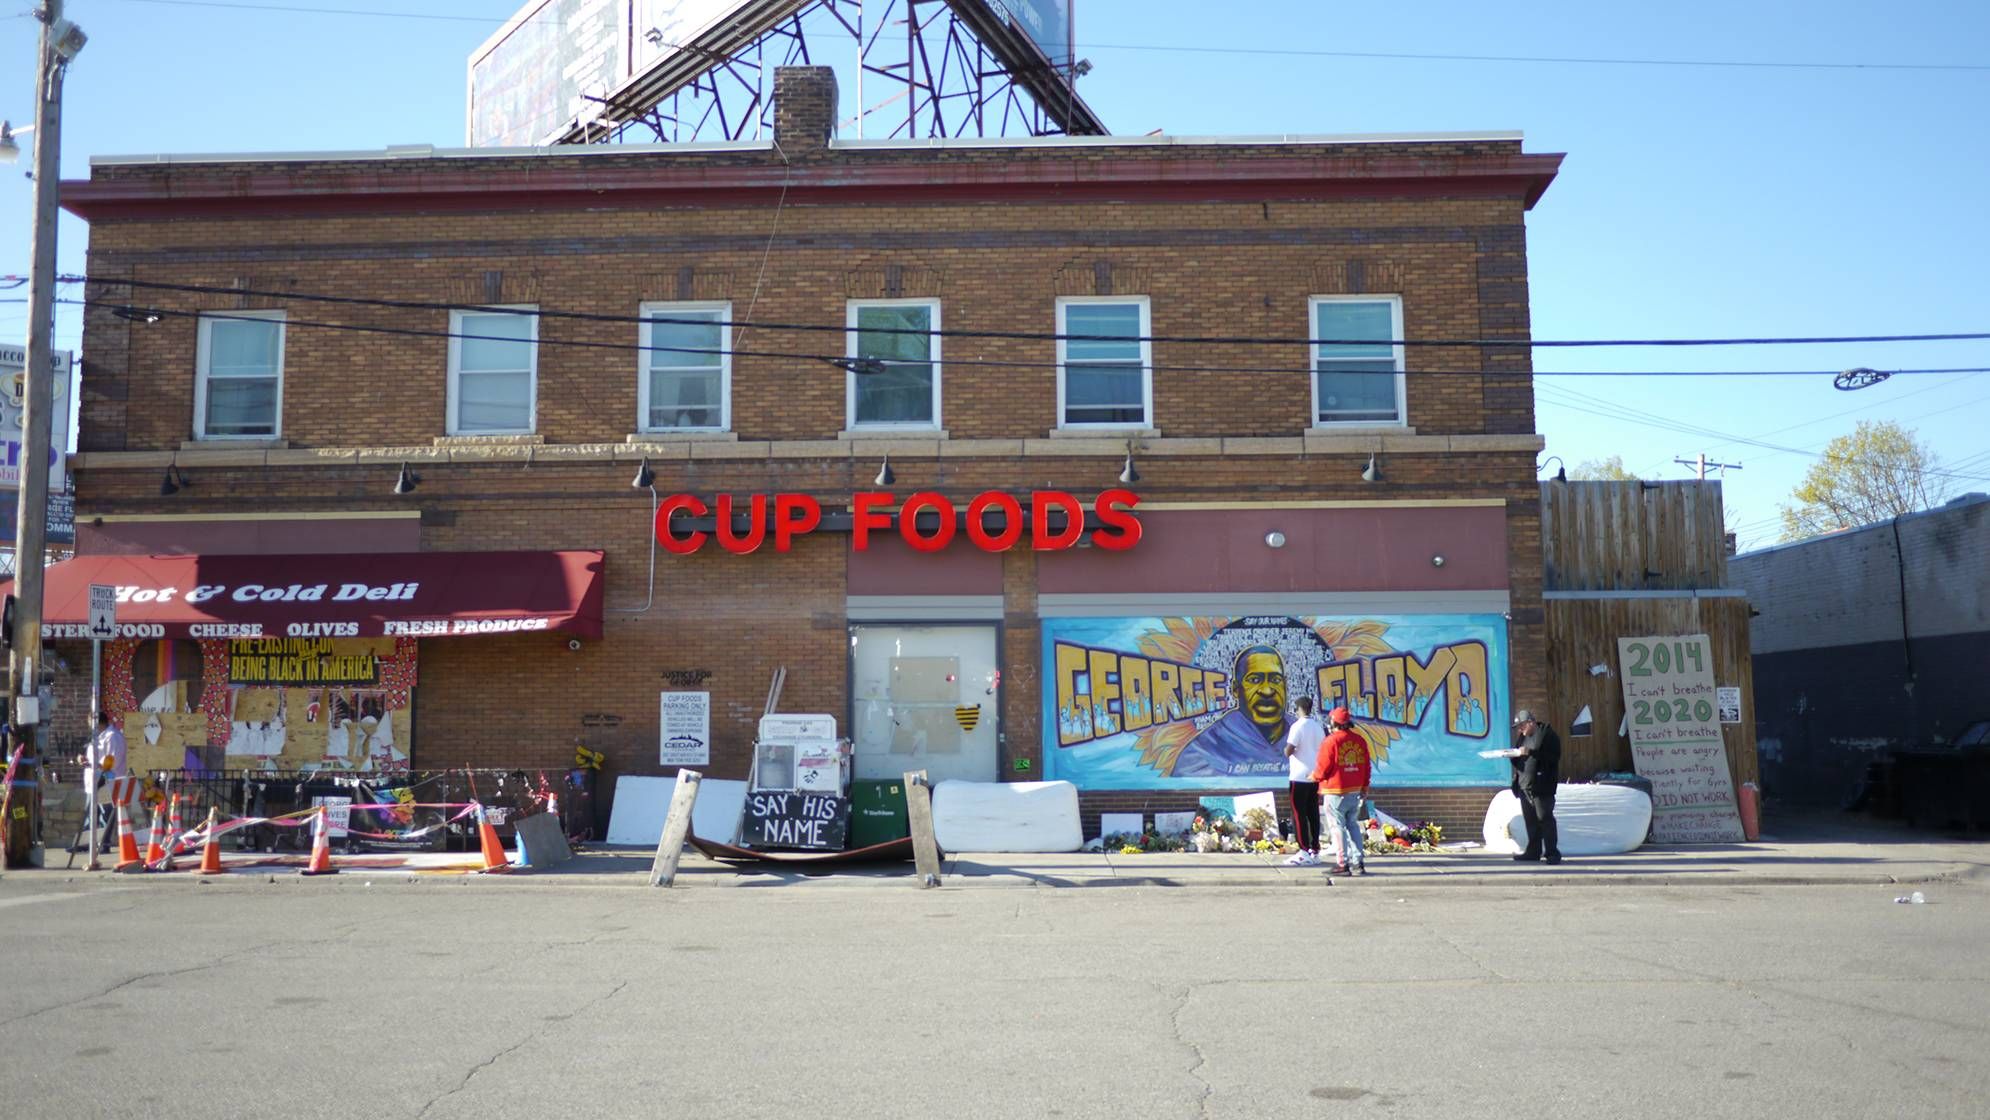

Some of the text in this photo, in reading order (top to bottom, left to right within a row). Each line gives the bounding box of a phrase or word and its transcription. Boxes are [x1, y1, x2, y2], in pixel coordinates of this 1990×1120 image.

[655, 490, 1142, 555] CUP FOODS
[92, 587, 114, 599] TRUCK
[115, 582, 419, 603] Hot & Cold Deli
[92, 600, 113, 611] ROUTE
[41, 623, 165, 638] STER FOOD
[189, 623, 263, 637] CHEESE
[287, 622, 359, 637] OLIVES
[383, 618, 548, 636] FRESH PRODUCE
[1627, 642, 1703, 677] 2014
[231, 656, 374, 681] BEING BLACK IN AMERICA
[1054, 641, 1229, 748] GEORGE
[1317, 638, 1491, 739] FLOYD
[1627, 682, 1712, 697] I can't breathe
[691, 702, 706, 710] ONLY
[1632, 698, 1712, 725] 2020
[1634, 727, 1718, 740] I can't breathe
[1636, 746, 1664, 760] People
[1692, 747, 1719, 760] angry
[1640, 765, 1715, 776] because waiting
[1653, 778, 1682, 791] tiently
[1681, 793, 1699, 804] NOT
[1701, 792, 1730, 802] WORK
[752, 795, 837, 819] SAY HIS
[764, 819, 828, 845] NAME
